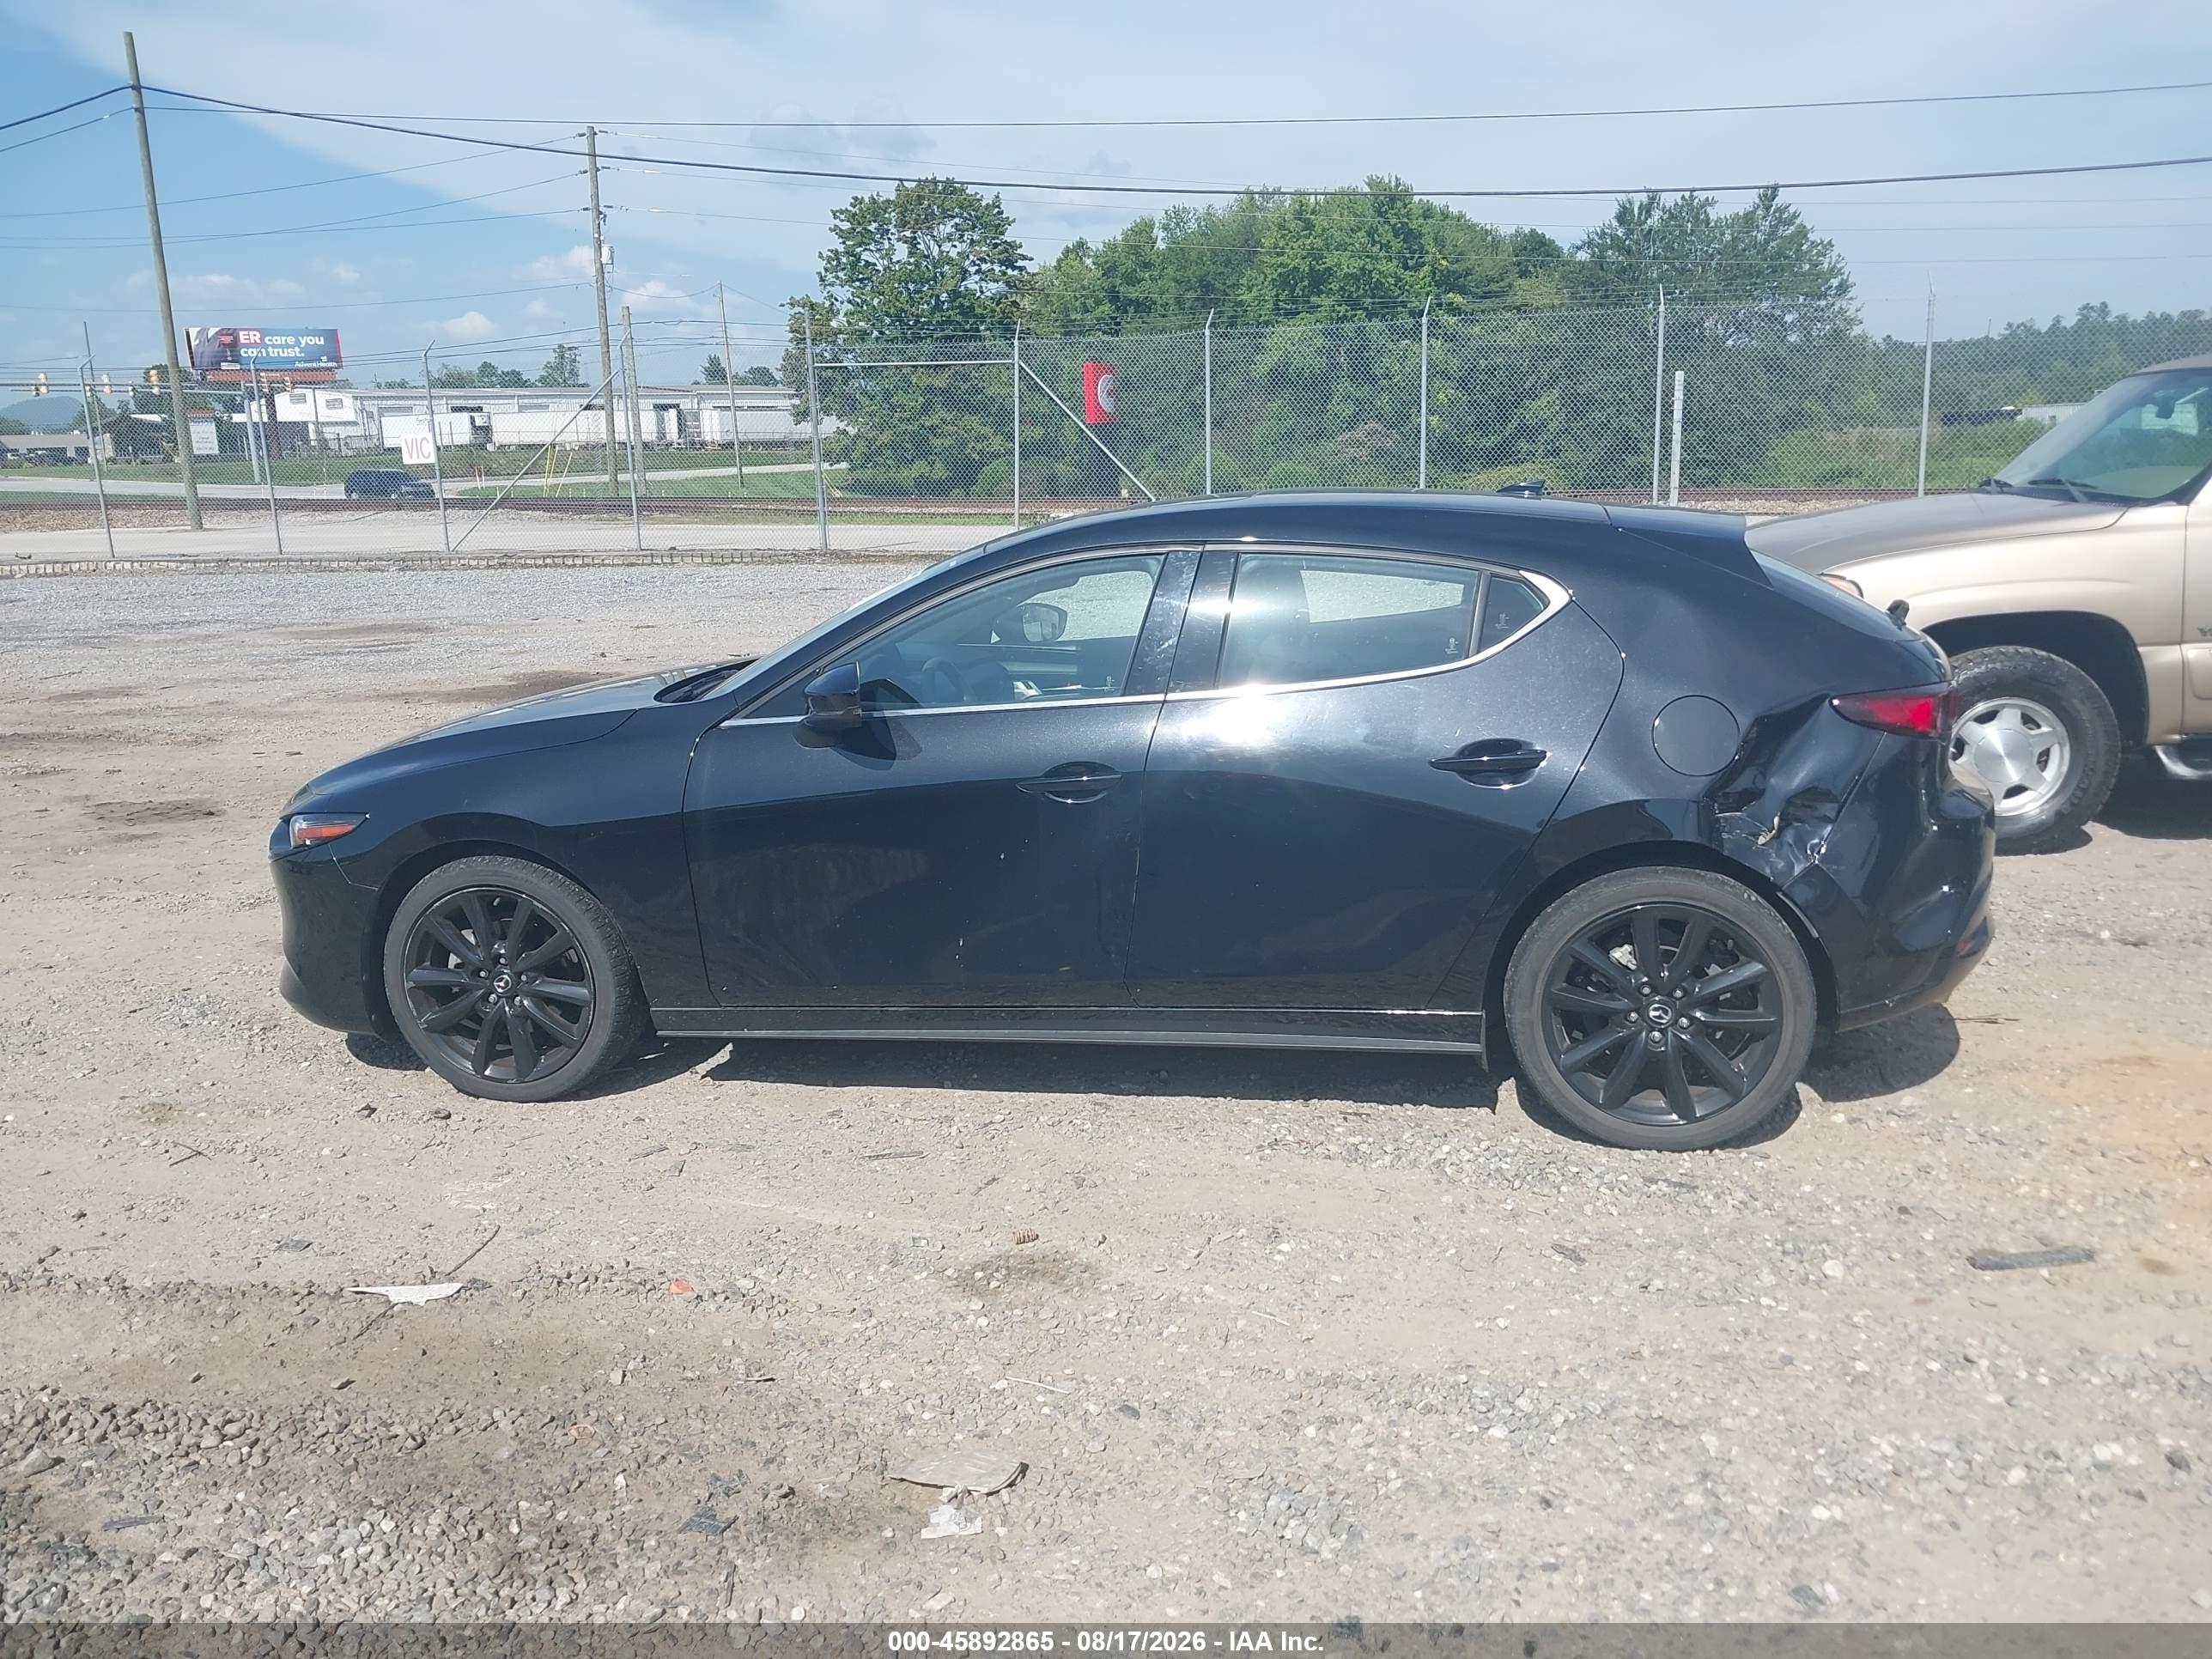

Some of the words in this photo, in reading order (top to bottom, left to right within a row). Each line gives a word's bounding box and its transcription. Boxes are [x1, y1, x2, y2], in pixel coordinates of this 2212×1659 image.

[239, 331, 261, 343] ER
[264, 336, 295, 344] care
[297, 336, 325, 347] you
[240, 347, 266, 357] can
[268, 347, 305, 357] trust.
[404, 436, 431, 459] VIC
